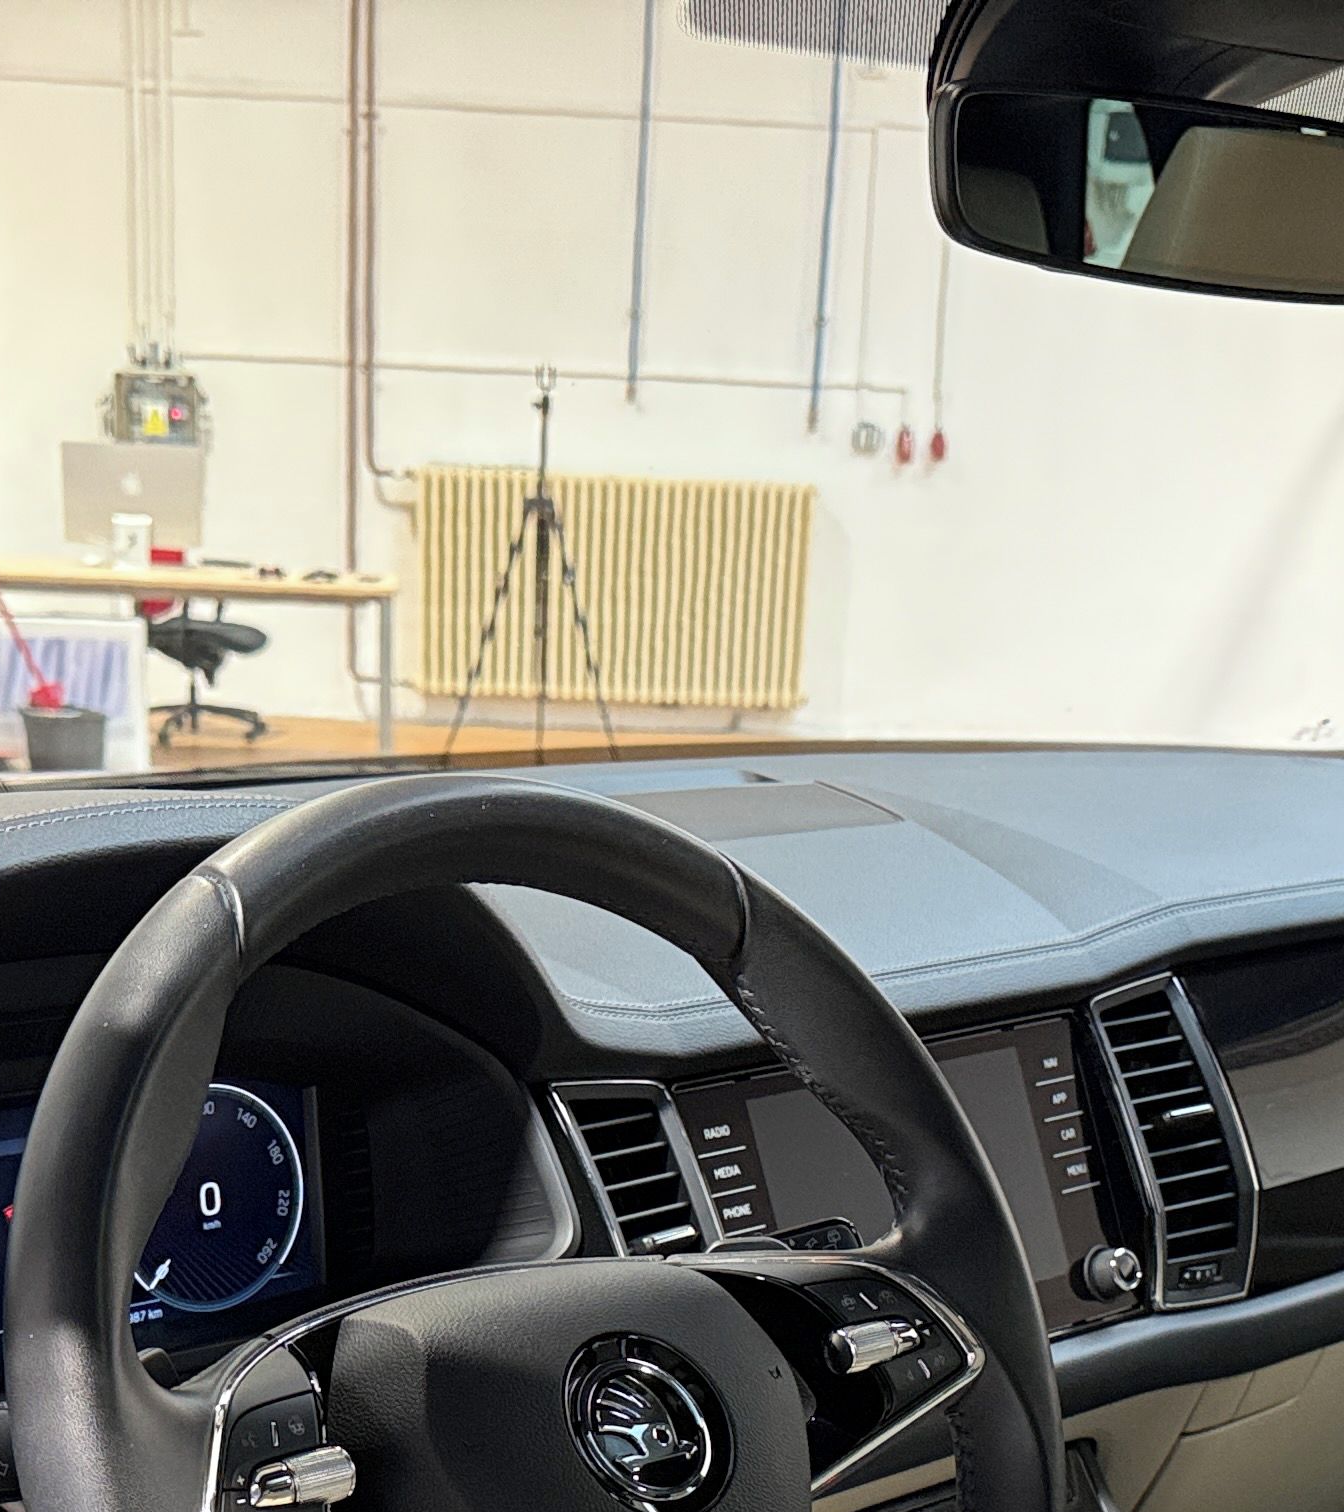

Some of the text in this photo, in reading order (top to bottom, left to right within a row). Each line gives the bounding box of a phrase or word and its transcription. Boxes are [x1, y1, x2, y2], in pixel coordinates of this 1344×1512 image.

[1052, 1091, 1068, 1104] APP
[236, 1107, 258, 1128] 140
[703, 1124, 731, 1140] RADIO
[1060, 1127, 1076, 1141] CAR
[267, 1139, 285, 1165] 180
[713, 1164, 741, 1180] MEDIA
[1066, 1163, 1088, 1177] MENU
[199, 1182, 222, 1216] 0
[276, 1189, 291, 1217] 220
[722, 1203, 752, 1220] PHONE
[256, 1237, 278, 1264] 260
[148, 1309, 163, 1320] km
